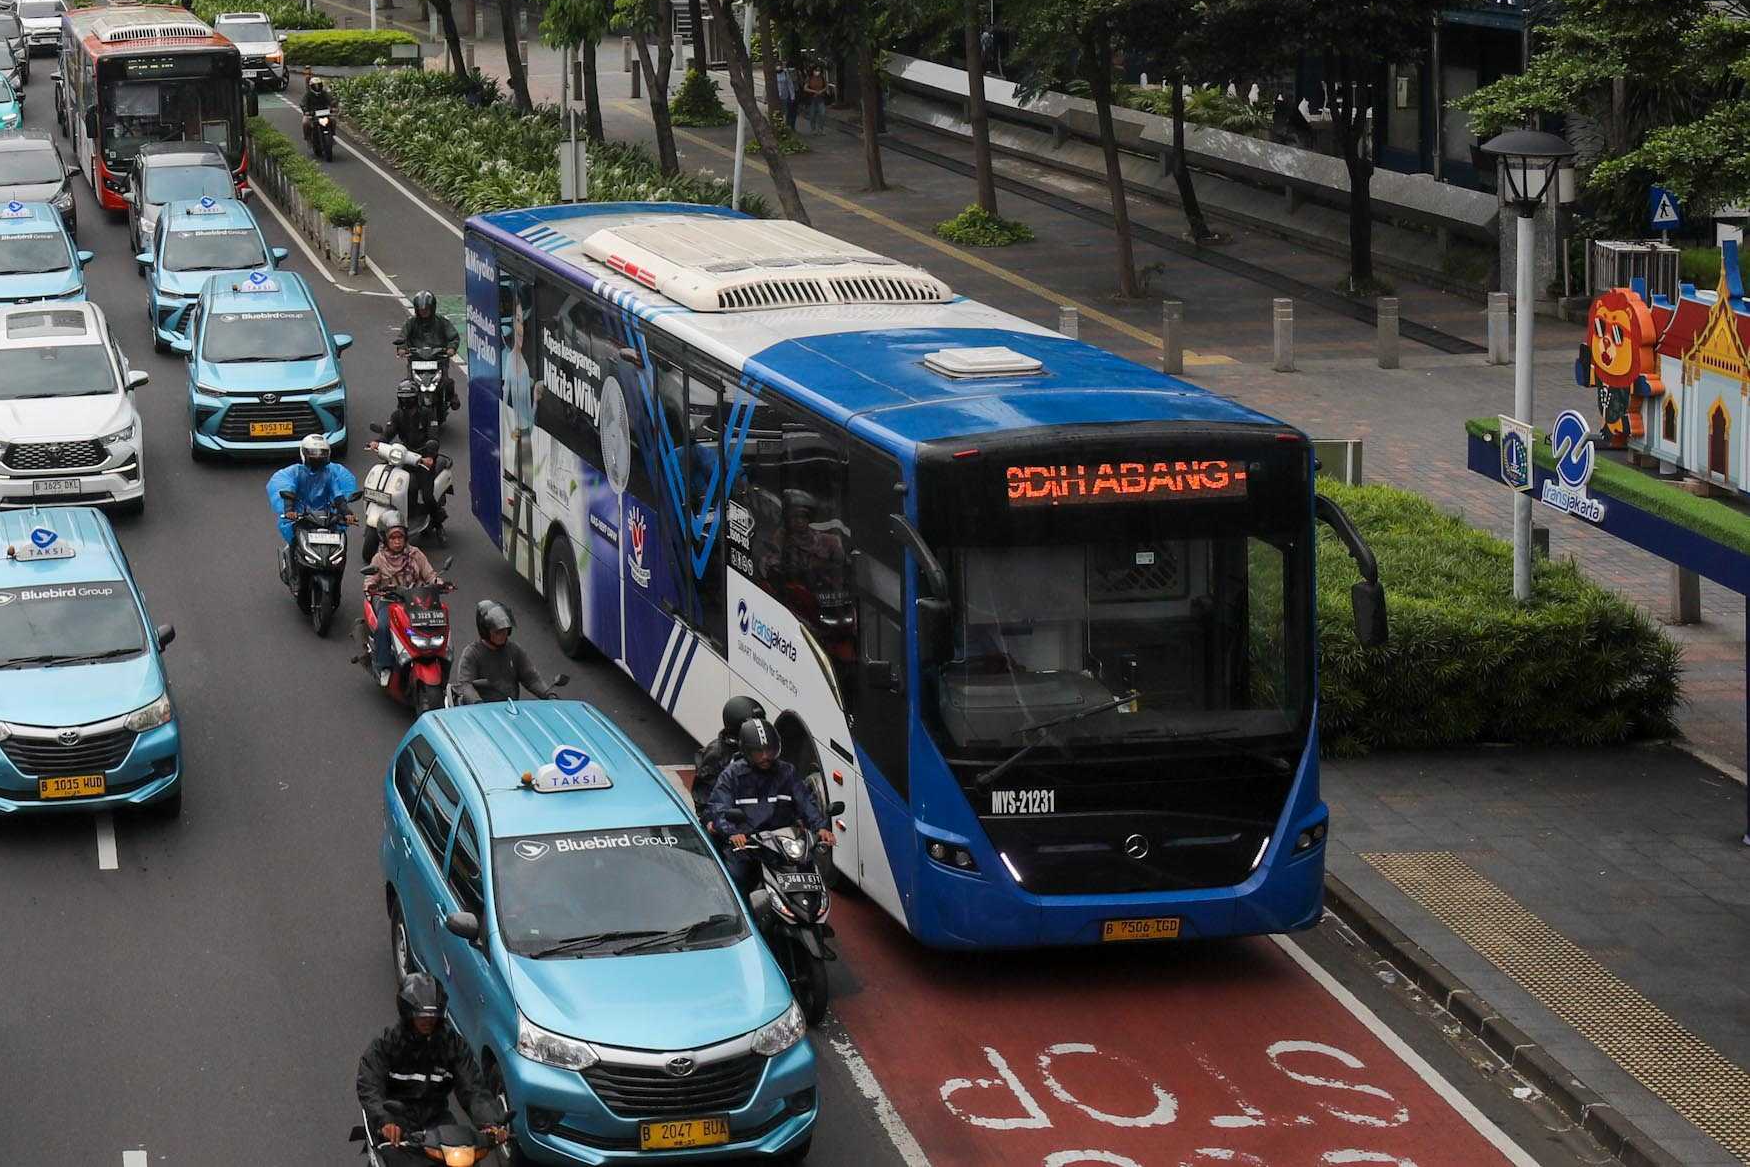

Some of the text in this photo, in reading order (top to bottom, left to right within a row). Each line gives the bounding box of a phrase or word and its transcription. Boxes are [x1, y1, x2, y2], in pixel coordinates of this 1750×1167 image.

[241, 312, 304, 320] Bluebird Group
[467, 323, 496, 366] Miyako
[543, 327, 600, 380] Kipas kesayangan
[543, 357, 601, 427] Nikita Willy
[1092, 461, 1229, 495] ABANG
[1543, 487, 1600, 520] transjakarta
[29, 547, 64, 556] TAKSI
[21, 586, 113, 601] Bluebird Group
[751, 613, 797, 662] transjakarta
[41, 781, 48, 792] B
[552, 775, 596, 786] TAKSI
[992, 790, 1055, 814] MYS-21231
[555, 834, 679, 852] Bluebird Group
[1106, 923, 1114, 934] B
[940, 1040, 1410, 1129] STOP
[643, 1120, 727, 1142] B 2047 BUA
